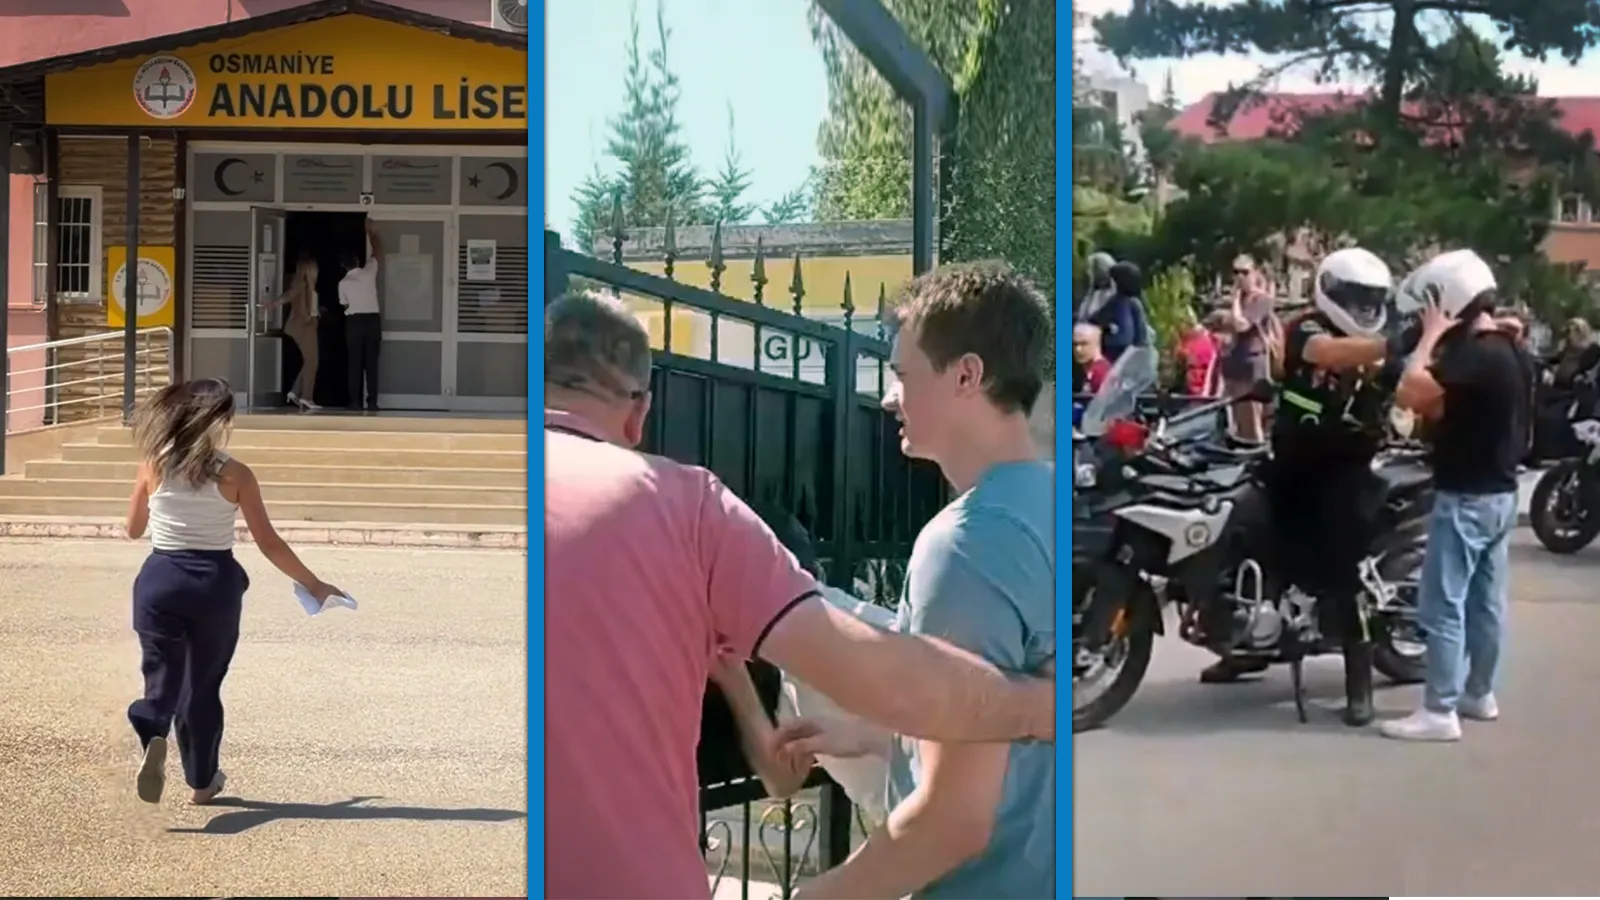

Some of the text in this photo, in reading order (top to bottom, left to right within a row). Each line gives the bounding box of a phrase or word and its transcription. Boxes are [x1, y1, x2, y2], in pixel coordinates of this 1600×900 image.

[209, 51, 334, 75] OSMANİYE
[208, 77, 525, 118] ANADOLU LİSE
